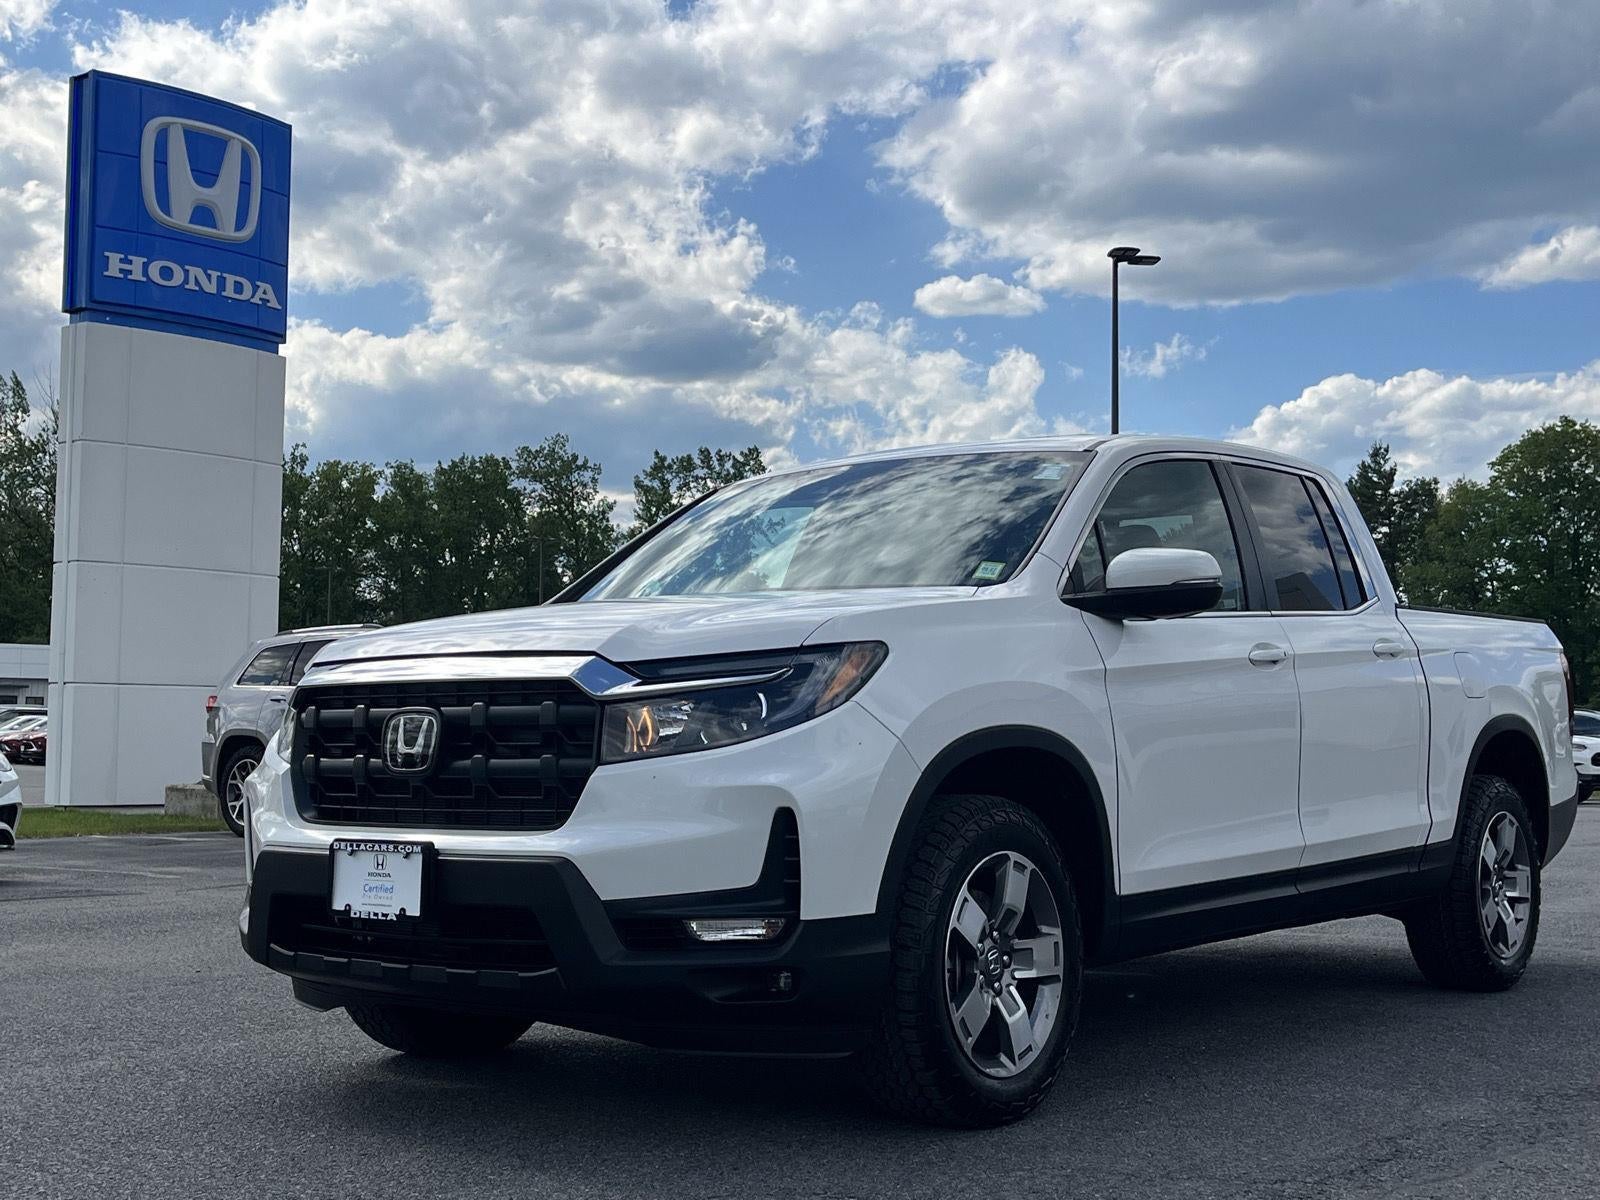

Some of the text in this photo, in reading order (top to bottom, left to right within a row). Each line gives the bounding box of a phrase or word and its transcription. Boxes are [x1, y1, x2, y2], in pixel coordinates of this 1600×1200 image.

[103, 251, 283, 310] HONDA
[333, 841, 422, 854] DELLACARS.COM
[367, 871, 392, 879] HONDA
[363, 883, 394, 894] Certified
[350, 910, 397, 921] DELLA
